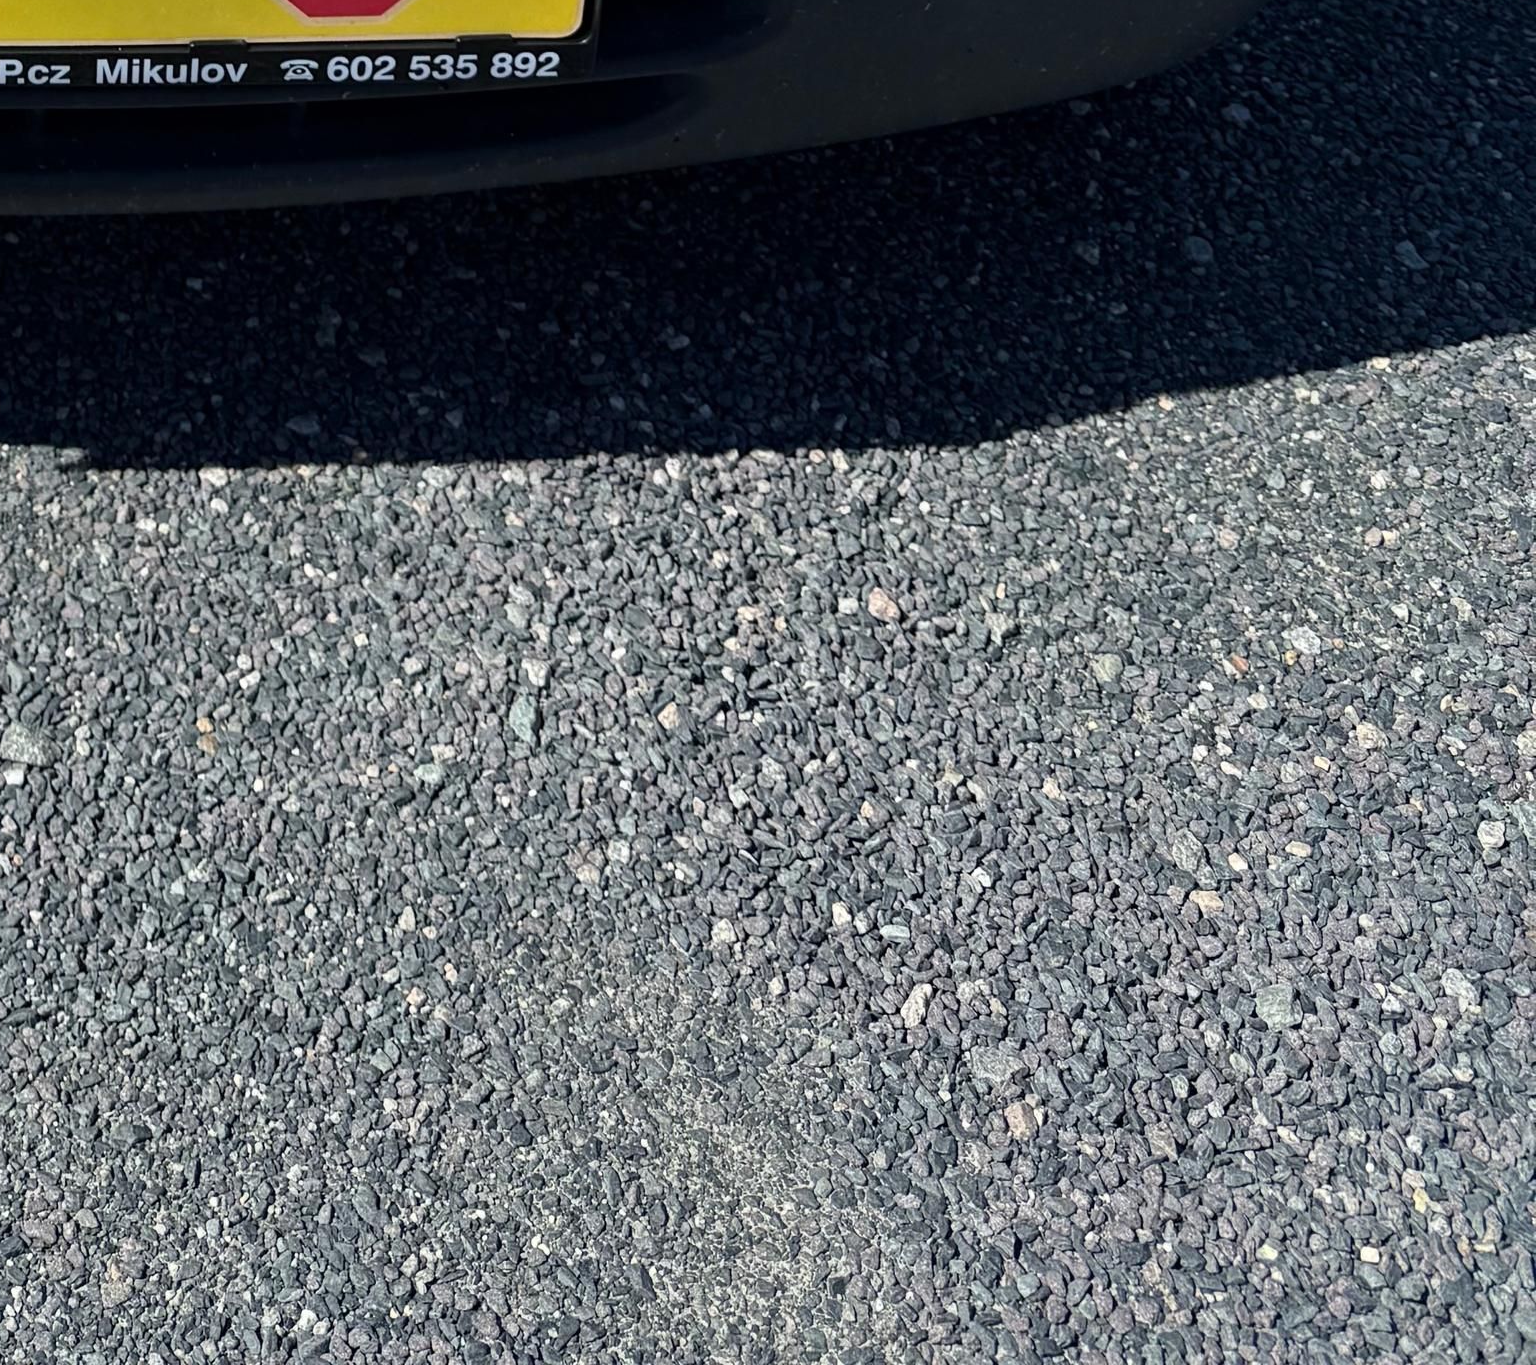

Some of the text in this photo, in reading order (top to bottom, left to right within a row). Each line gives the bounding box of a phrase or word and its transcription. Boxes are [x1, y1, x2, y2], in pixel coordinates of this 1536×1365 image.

[95, 57, 249, 86] Mikulov
[326, 55, 396, 83] 602
[407, 53, 479, 82] 535
[489, 51, 561, 79] 892
